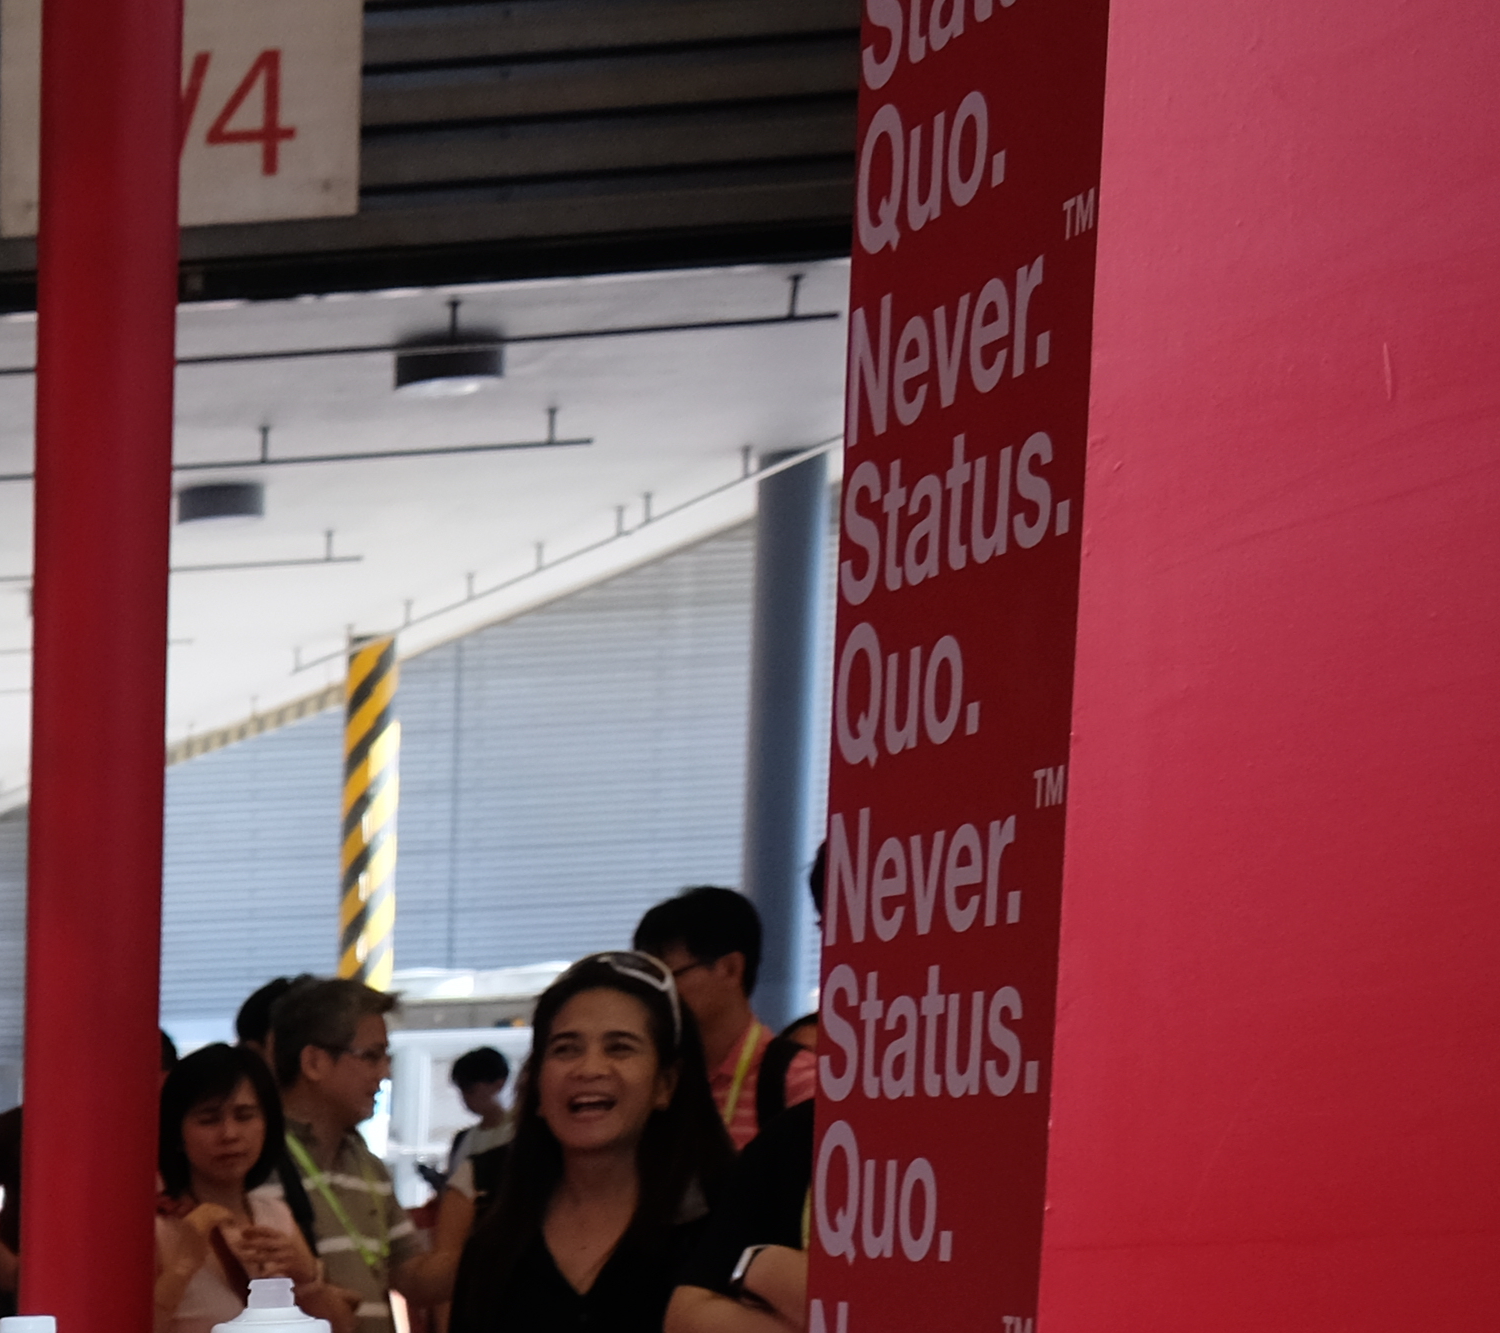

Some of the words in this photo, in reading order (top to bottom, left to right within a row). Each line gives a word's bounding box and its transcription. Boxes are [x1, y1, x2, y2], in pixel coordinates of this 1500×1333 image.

[179, 47, 297, 178] 4
[856, 91, 1007, 255] Quo.
[847, 254, 1052, 448] Never.
[840, 431, 1072, 606] Status.
[836, 622, 980, 767] Quo.
[824, 807, 1022, 947] Never.
[818, 963, 1040, 1101] Status.
[815, 1120, 954, 1265] Quo.
